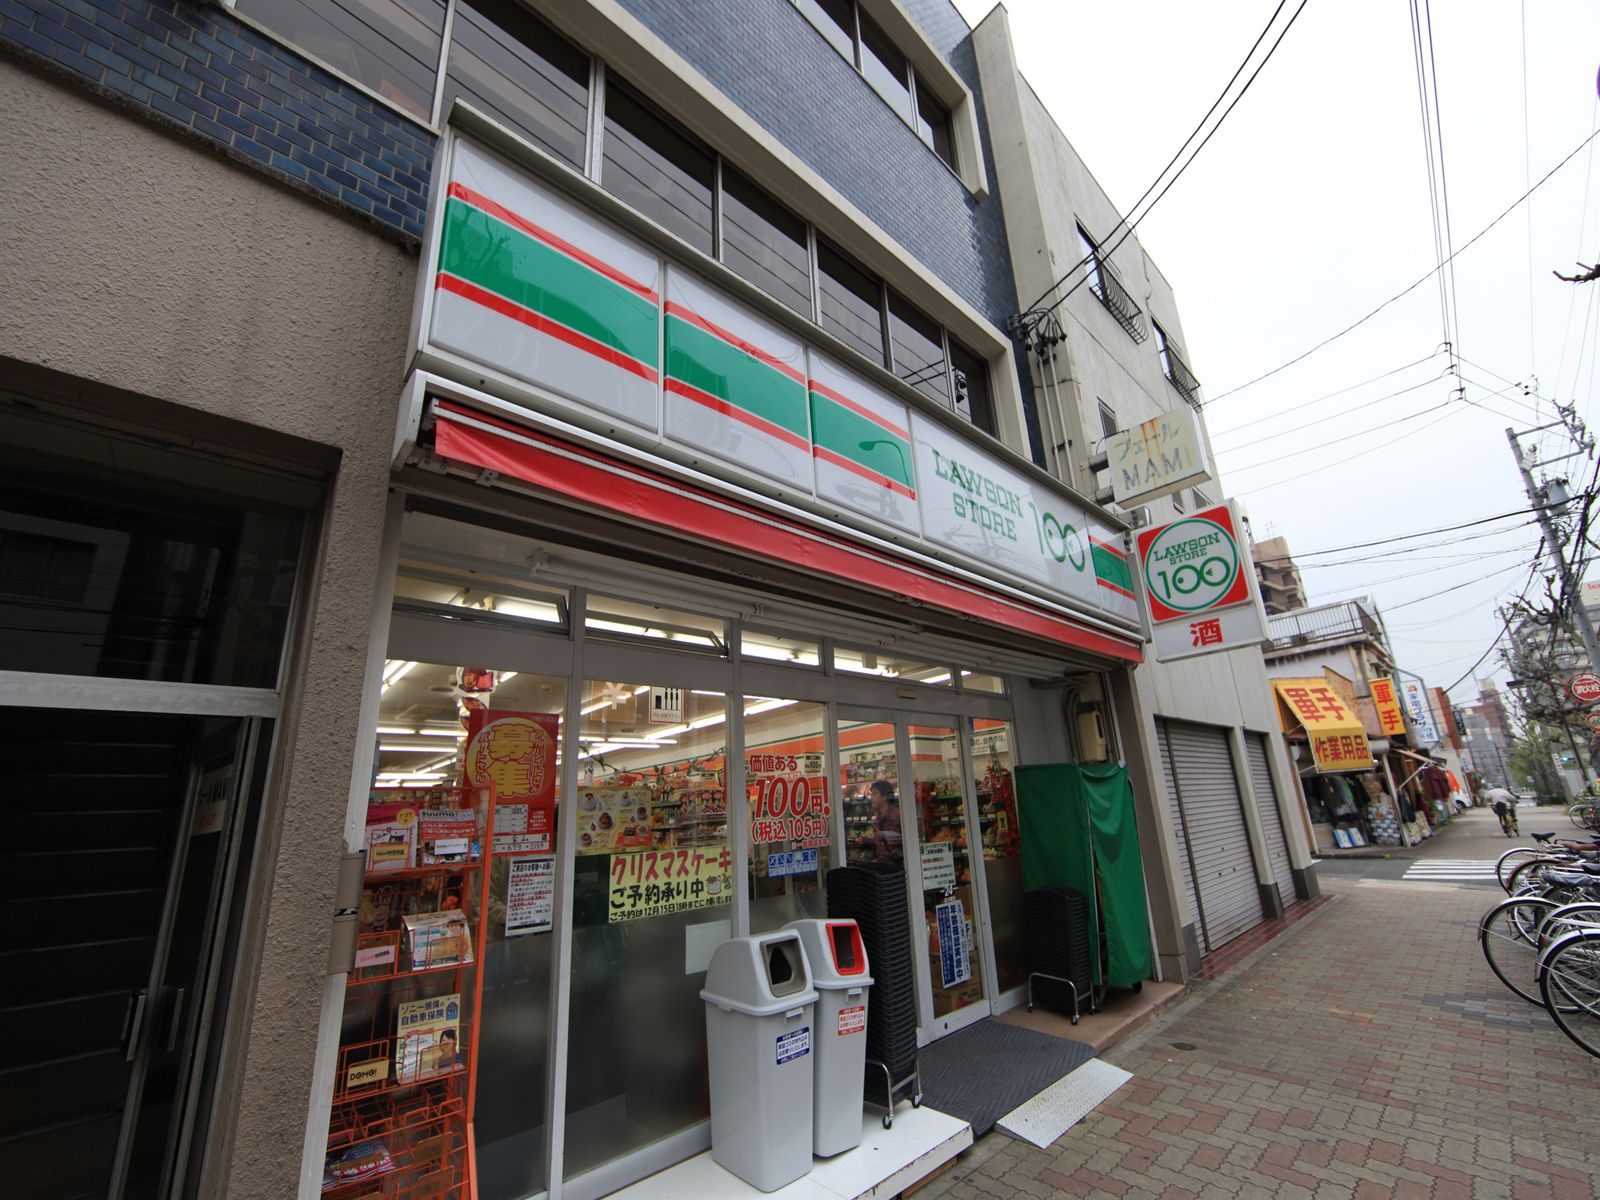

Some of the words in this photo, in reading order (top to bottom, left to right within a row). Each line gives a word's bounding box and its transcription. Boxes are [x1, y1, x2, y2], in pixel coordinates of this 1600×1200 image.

[932, 448, 1025, 519] LAWSON
[1122, 446, 1192, 490] MAMI
[952, 495, 1017, 543] STORE
[1028, 500, 1086, 573] 100
[1153, 532, 1221, 562] LAWSON
[1169, 548, 1208, 565] STORE
[1157, 556, 1231, 599] 100
[1190, 618, 1223, 648] 酒
[1283, 687, 1346, 723] 軍手
[1373, 683, 1400, 731] 軍手
[750, 753, 798, 773] 価値ある
[1314, 735, 1369, 763] 作業用品
[611, 846, 731, 885] クリスマスケーキ
[610, 878, 704, 909] ご予約承り中
[401, 1008, 444, 1025] 自動車保険
